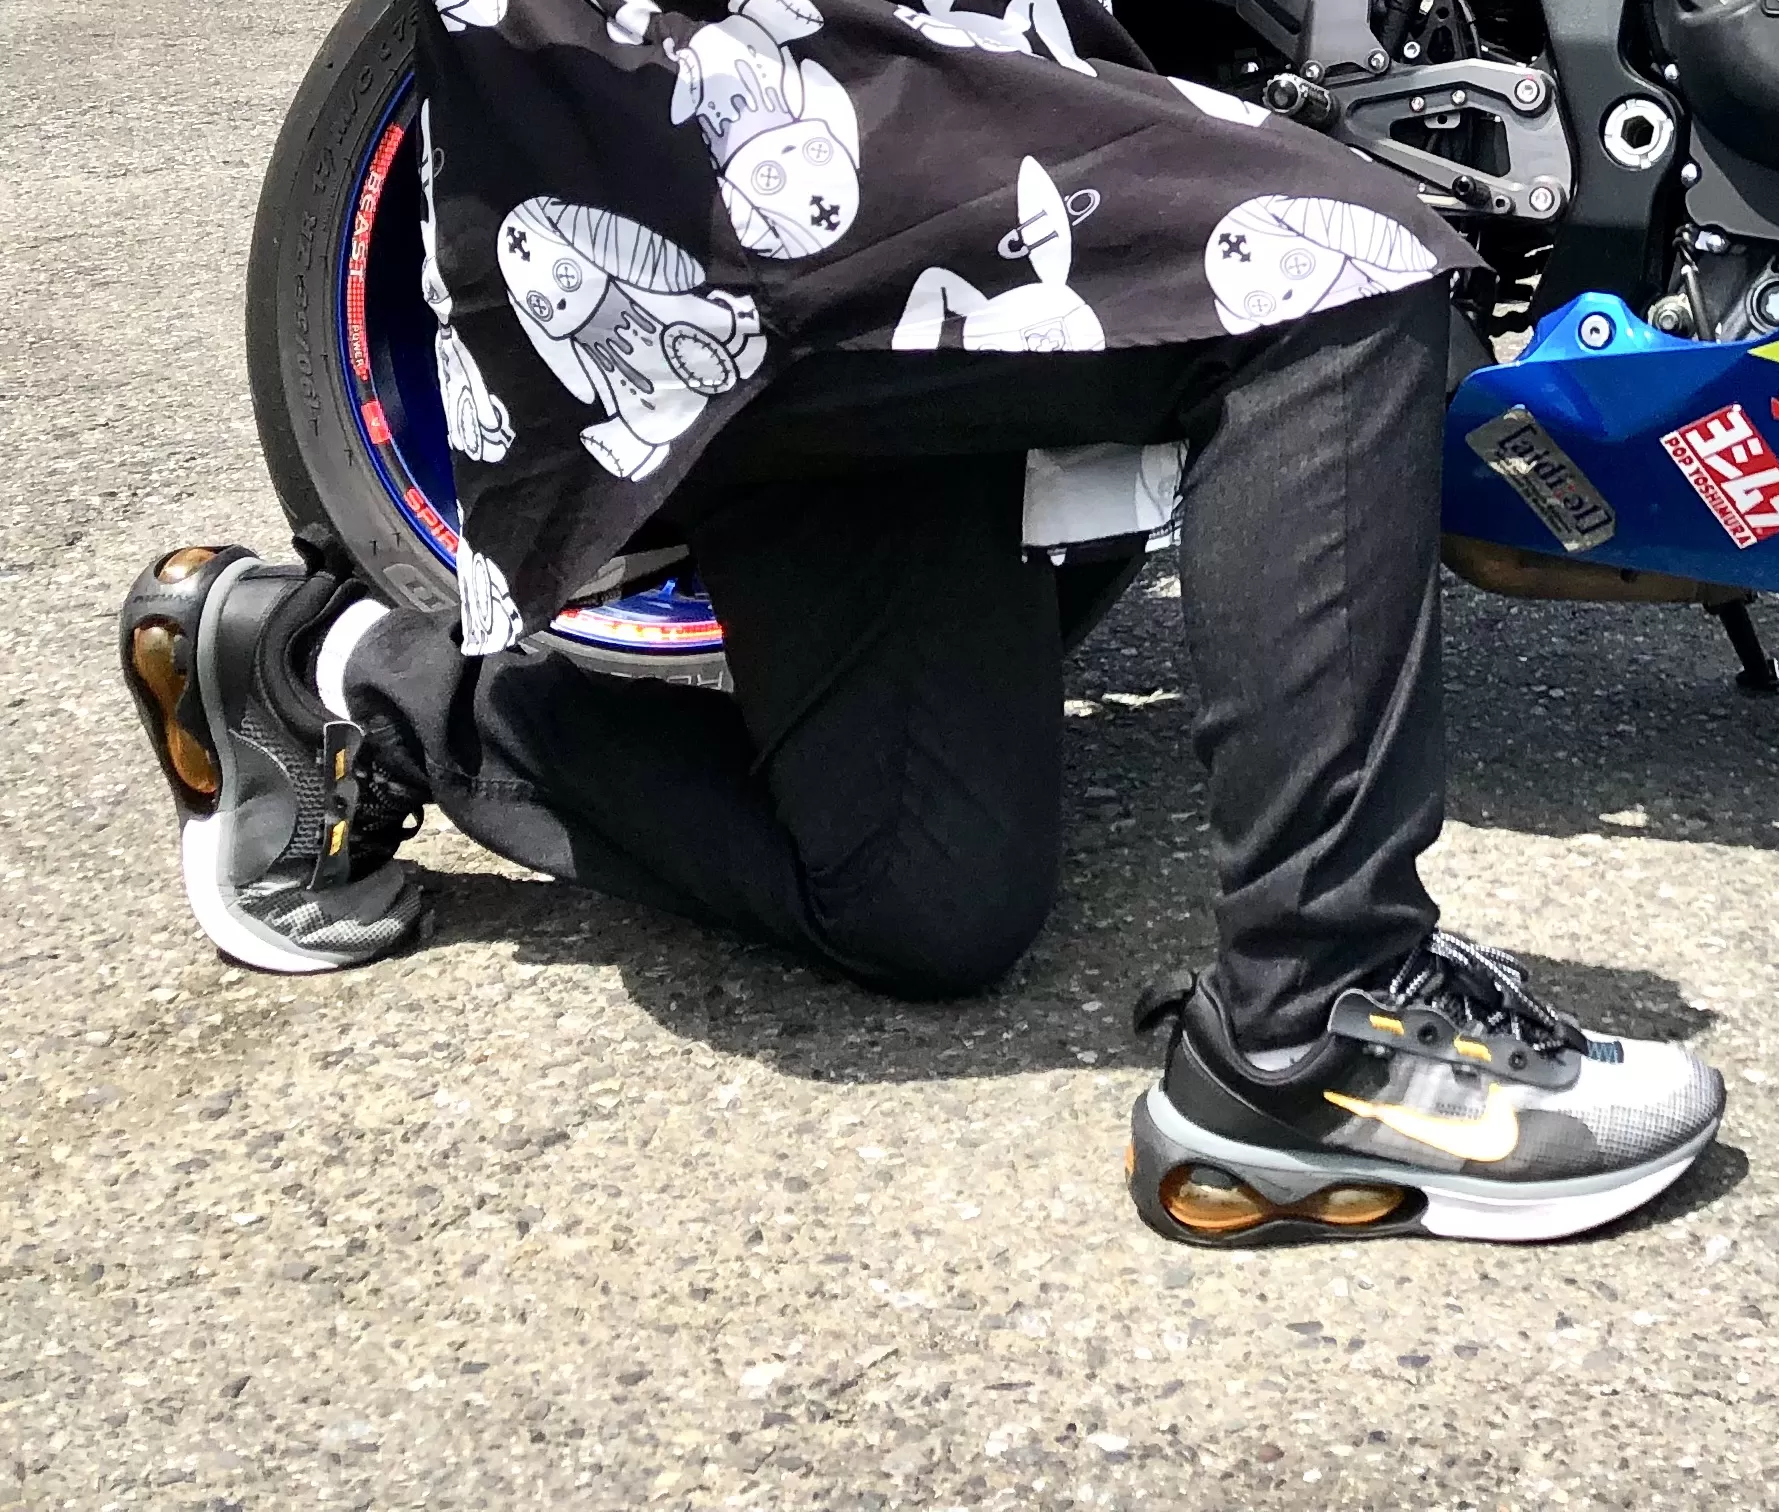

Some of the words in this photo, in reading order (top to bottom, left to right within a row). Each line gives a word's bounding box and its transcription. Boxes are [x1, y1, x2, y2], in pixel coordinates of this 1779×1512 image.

[345, 169, 383, 282] BEAST
[402, 487, 461, 556] SPIR
[1664, 434, 1694, 469] POP
[1691, 466, 1752, 548] YOSHIMURA
